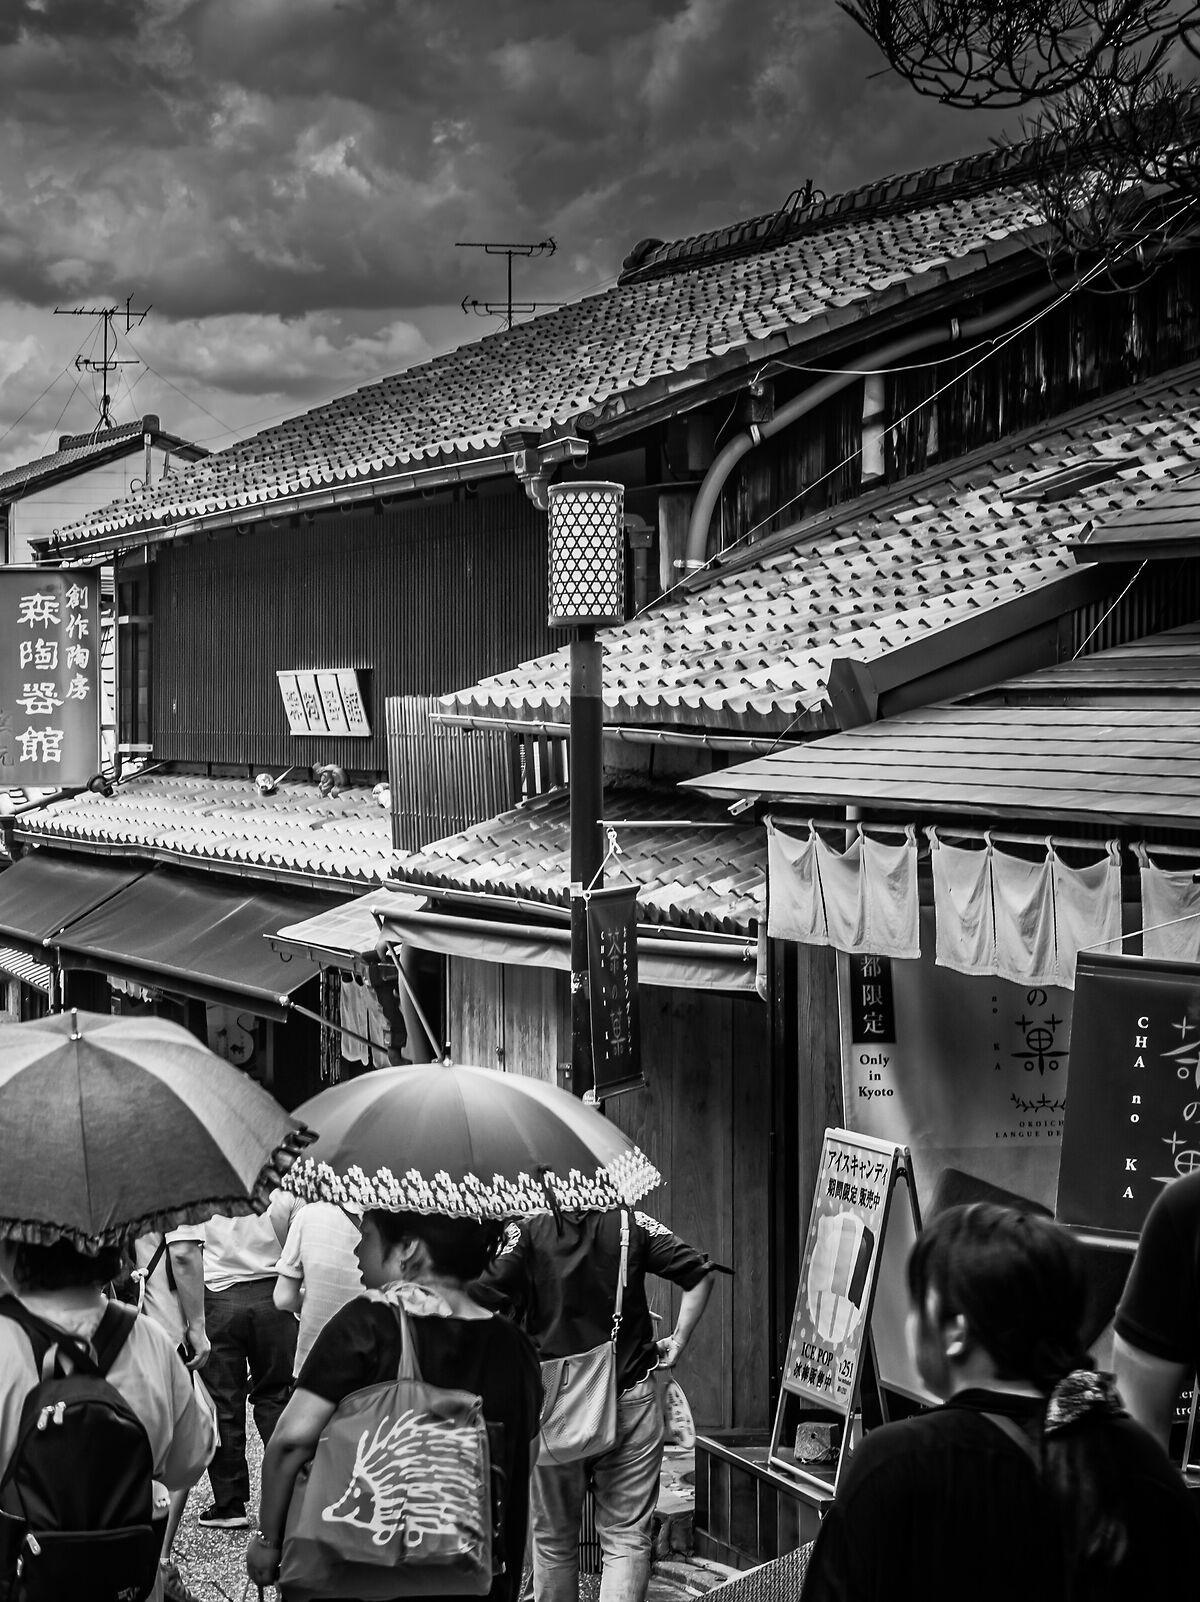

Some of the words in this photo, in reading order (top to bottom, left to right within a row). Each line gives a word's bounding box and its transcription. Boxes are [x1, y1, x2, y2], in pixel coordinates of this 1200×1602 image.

[65, 583, 90, 700] 創作陶房
[15, 592, 65, 763] 森陶器館
[1133, 1016, 1149, 1068] CHA
[859, 1053, 890, 1068] Only
[869, 1070, 882, 1081] in
[858, 1086, 894, 1100] Kyoto
[995, 1130, 1041, 1139] LANGUE
[827, 1150, 888, 1186] アイスキャンディ
[1122, 1158, 1137, 1199] KA
[826, 1177, 858, 1205] 期間限定
[858, 1187, 881, 1211] 販売中
[801, 1341, 817, 1361] ICE
[816, 1347, 834, 1367] POP
